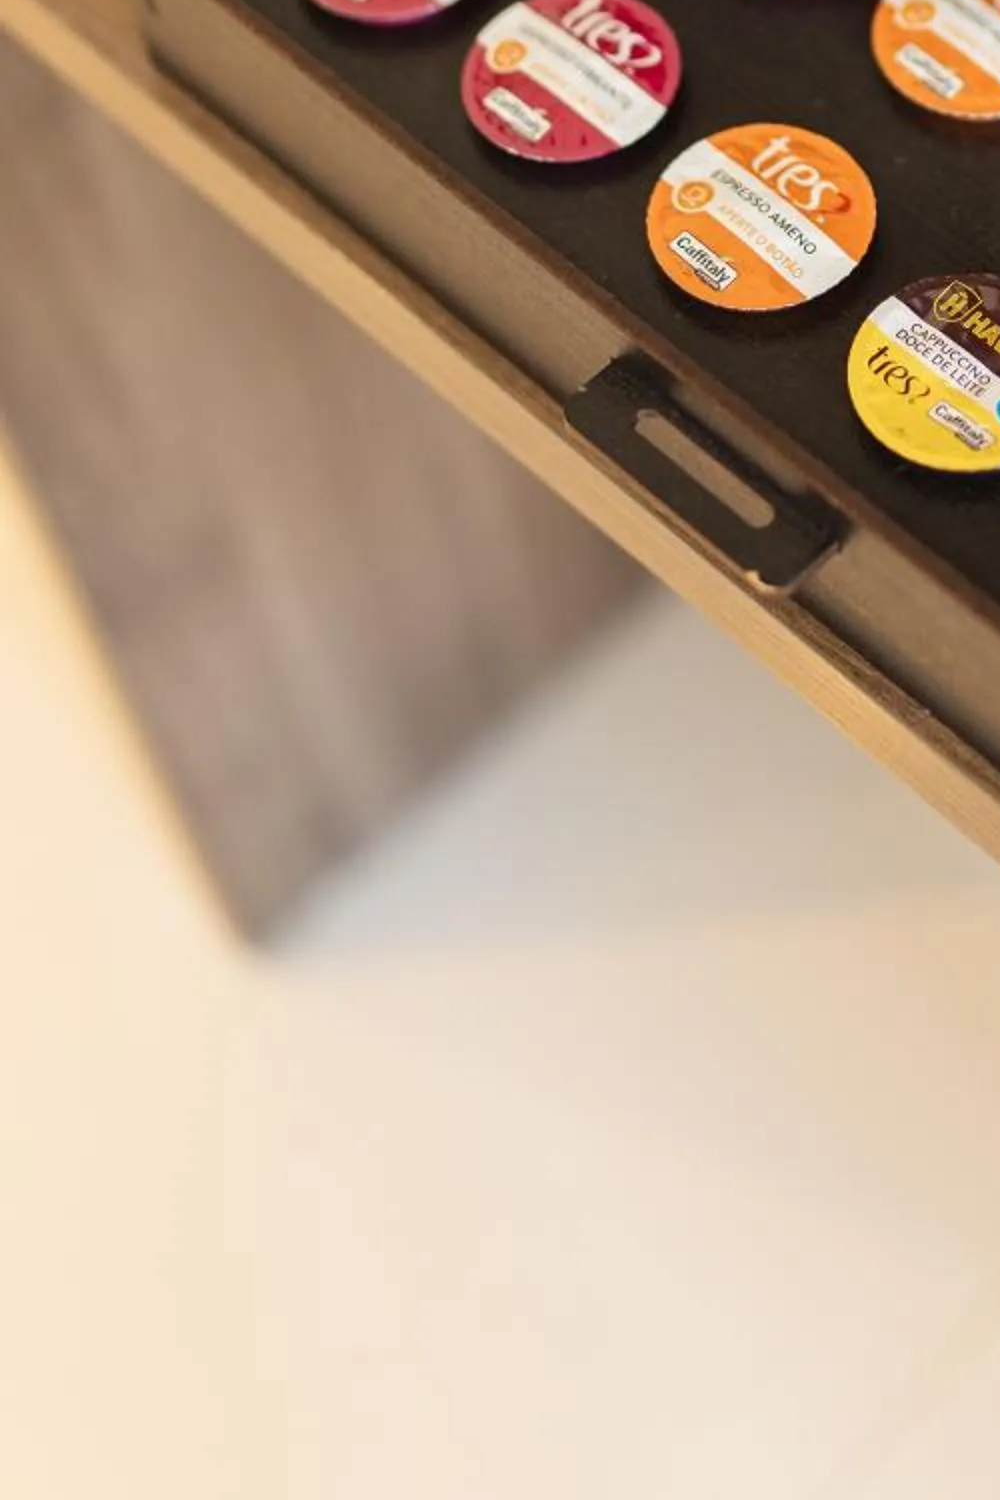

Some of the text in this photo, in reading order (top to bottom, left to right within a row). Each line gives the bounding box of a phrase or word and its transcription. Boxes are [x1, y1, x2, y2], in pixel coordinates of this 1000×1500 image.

[709, 168, 818, 256] ESPRESSO AMENO
[676, 236, 732, 285] Caffitaly
[895, 328, 990, 398] DOCE DE LEITE
[909, 322, 992, 386] CAPPUCCINO
